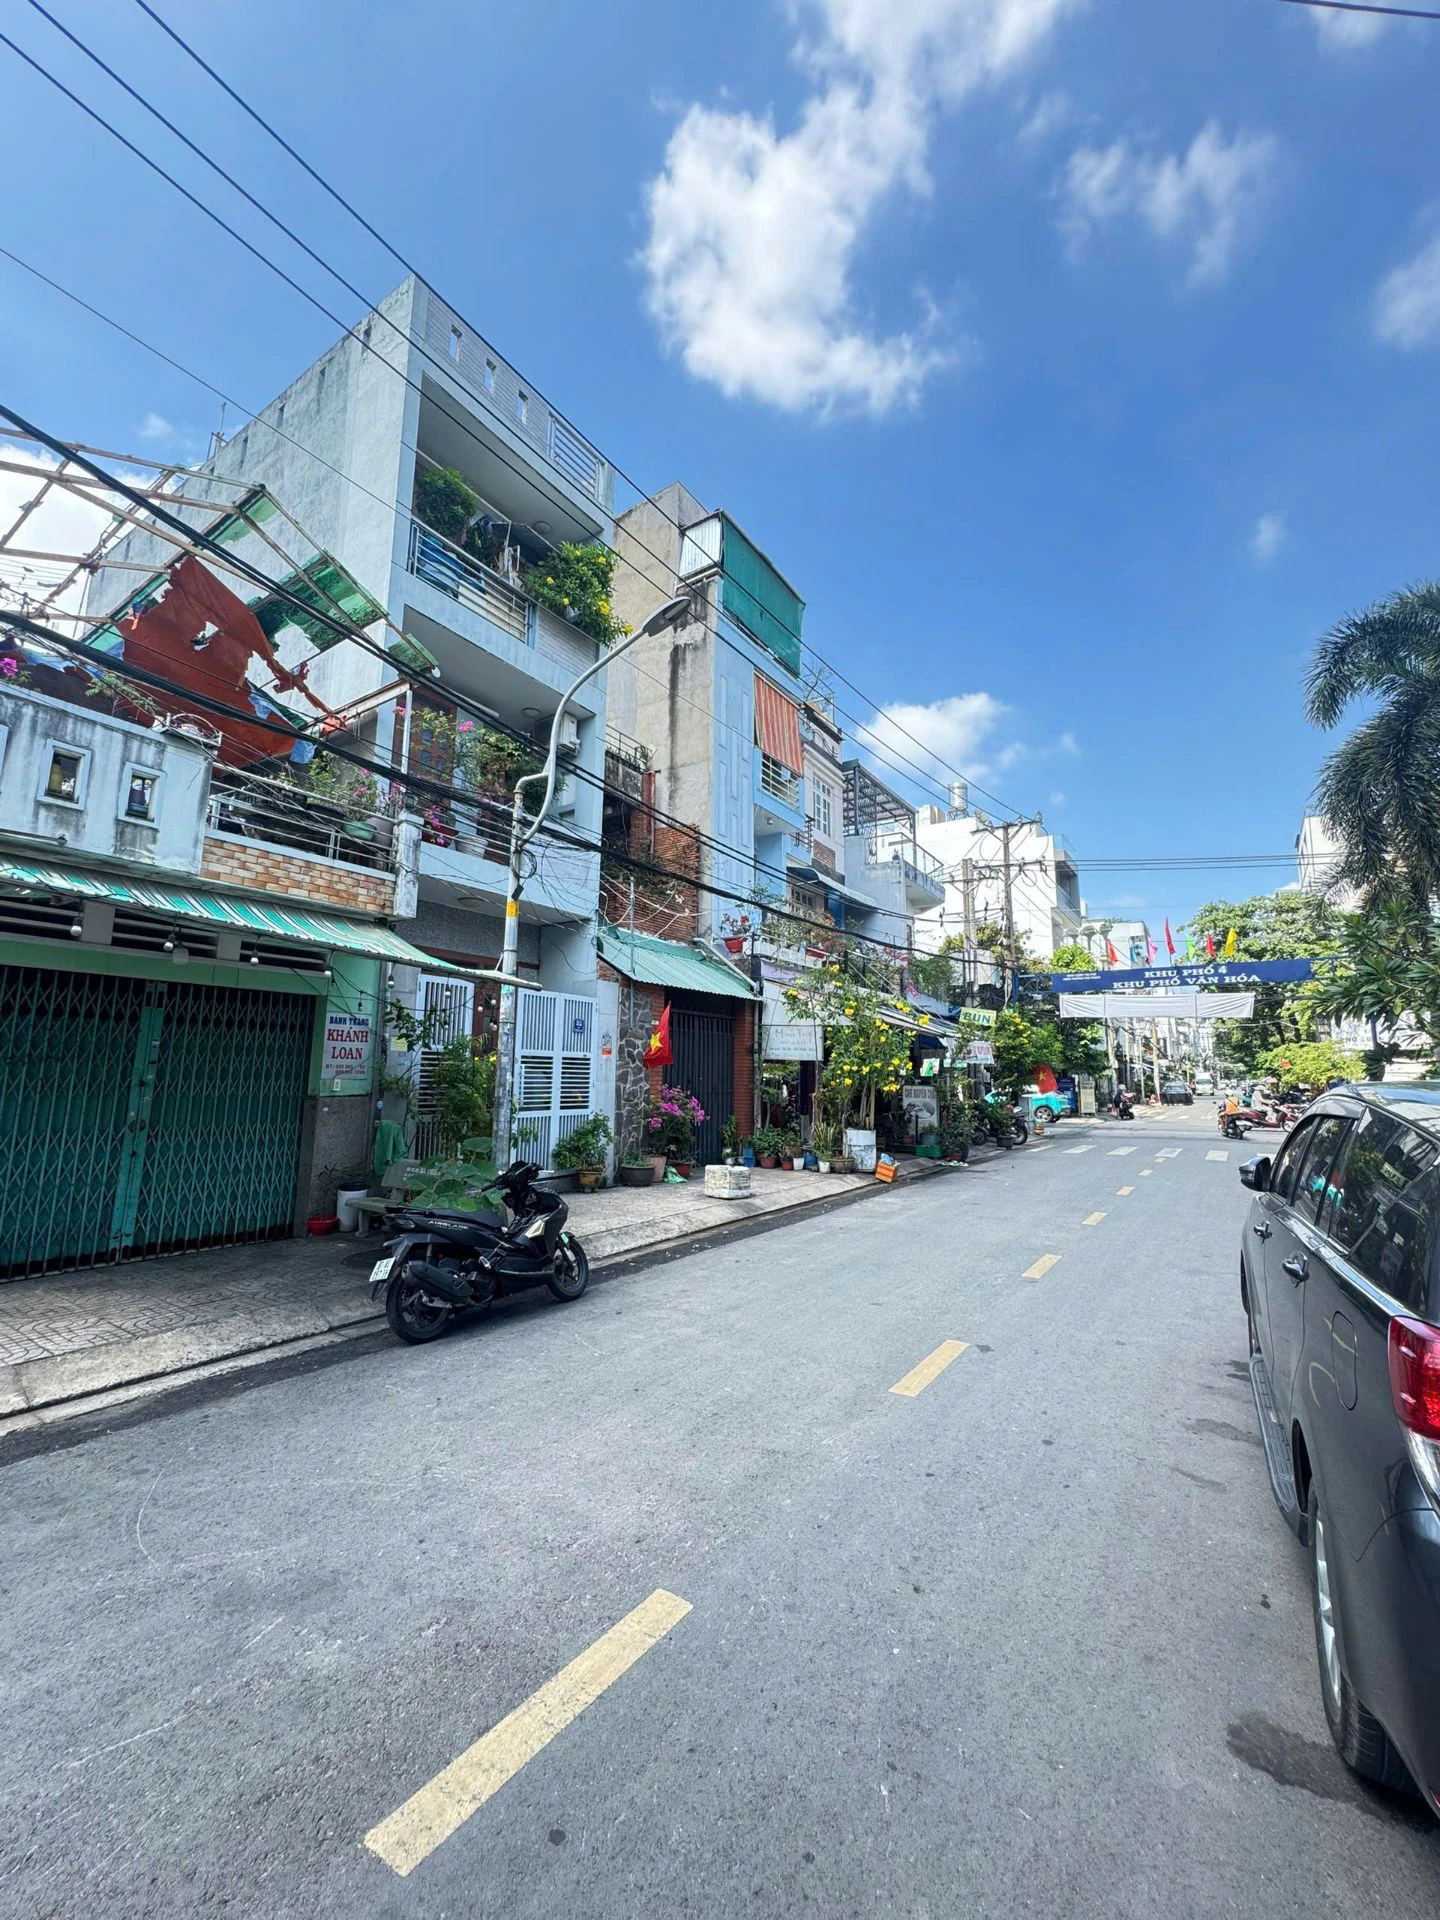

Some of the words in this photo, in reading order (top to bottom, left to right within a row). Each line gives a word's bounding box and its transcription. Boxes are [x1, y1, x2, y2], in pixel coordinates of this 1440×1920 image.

[1144, 970, 1177, 979] KHU
[1182, 964, 1215, 977] PHỐ
[1217, 965, 1228, 974] 4
[1112, 980, 1145, 989] KHU
[1149, 975, 1181, 987] PHỐ
[1224, 973, 1262, 983] HÓA
[327, 1026, 369, 1043] KHÁNH
[331, 1046, 363, 1060] LOAN
